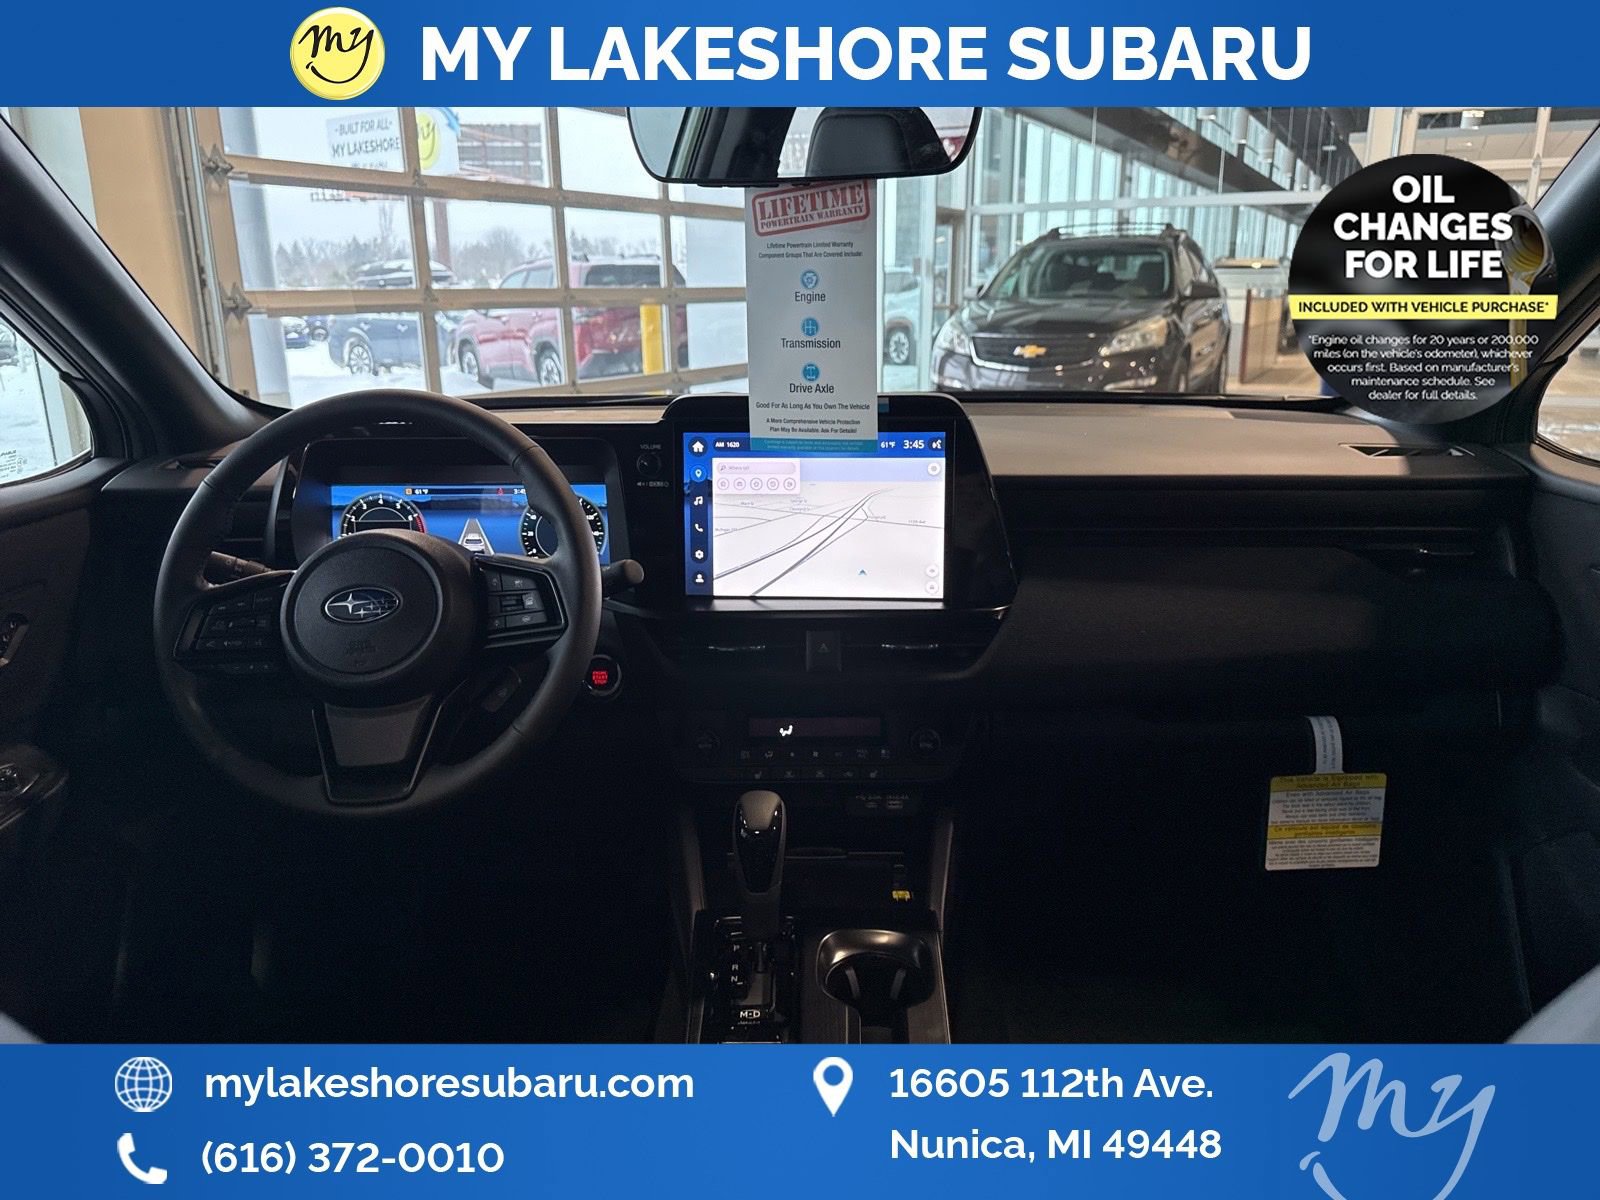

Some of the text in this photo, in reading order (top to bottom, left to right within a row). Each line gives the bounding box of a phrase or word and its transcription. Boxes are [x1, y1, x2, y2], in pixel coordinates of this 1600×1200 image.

[360, 119, 375, 133] FOR
[331, 137, 401, 158] MY LAKESHORE
[758, 184, 863, 221] LIFETIME
[761, 205, 864, 230] POWERTRAIN WARRANTY
[794, 291, 826, 305] Engine
[781, 338, 841, 349] Transmission
[789, 383, 835, 393] Drive Axle
[789, 403, 803, 411] Long
[903, 440, 925, 449] 3:45
[731, 975, 738, 983] N
